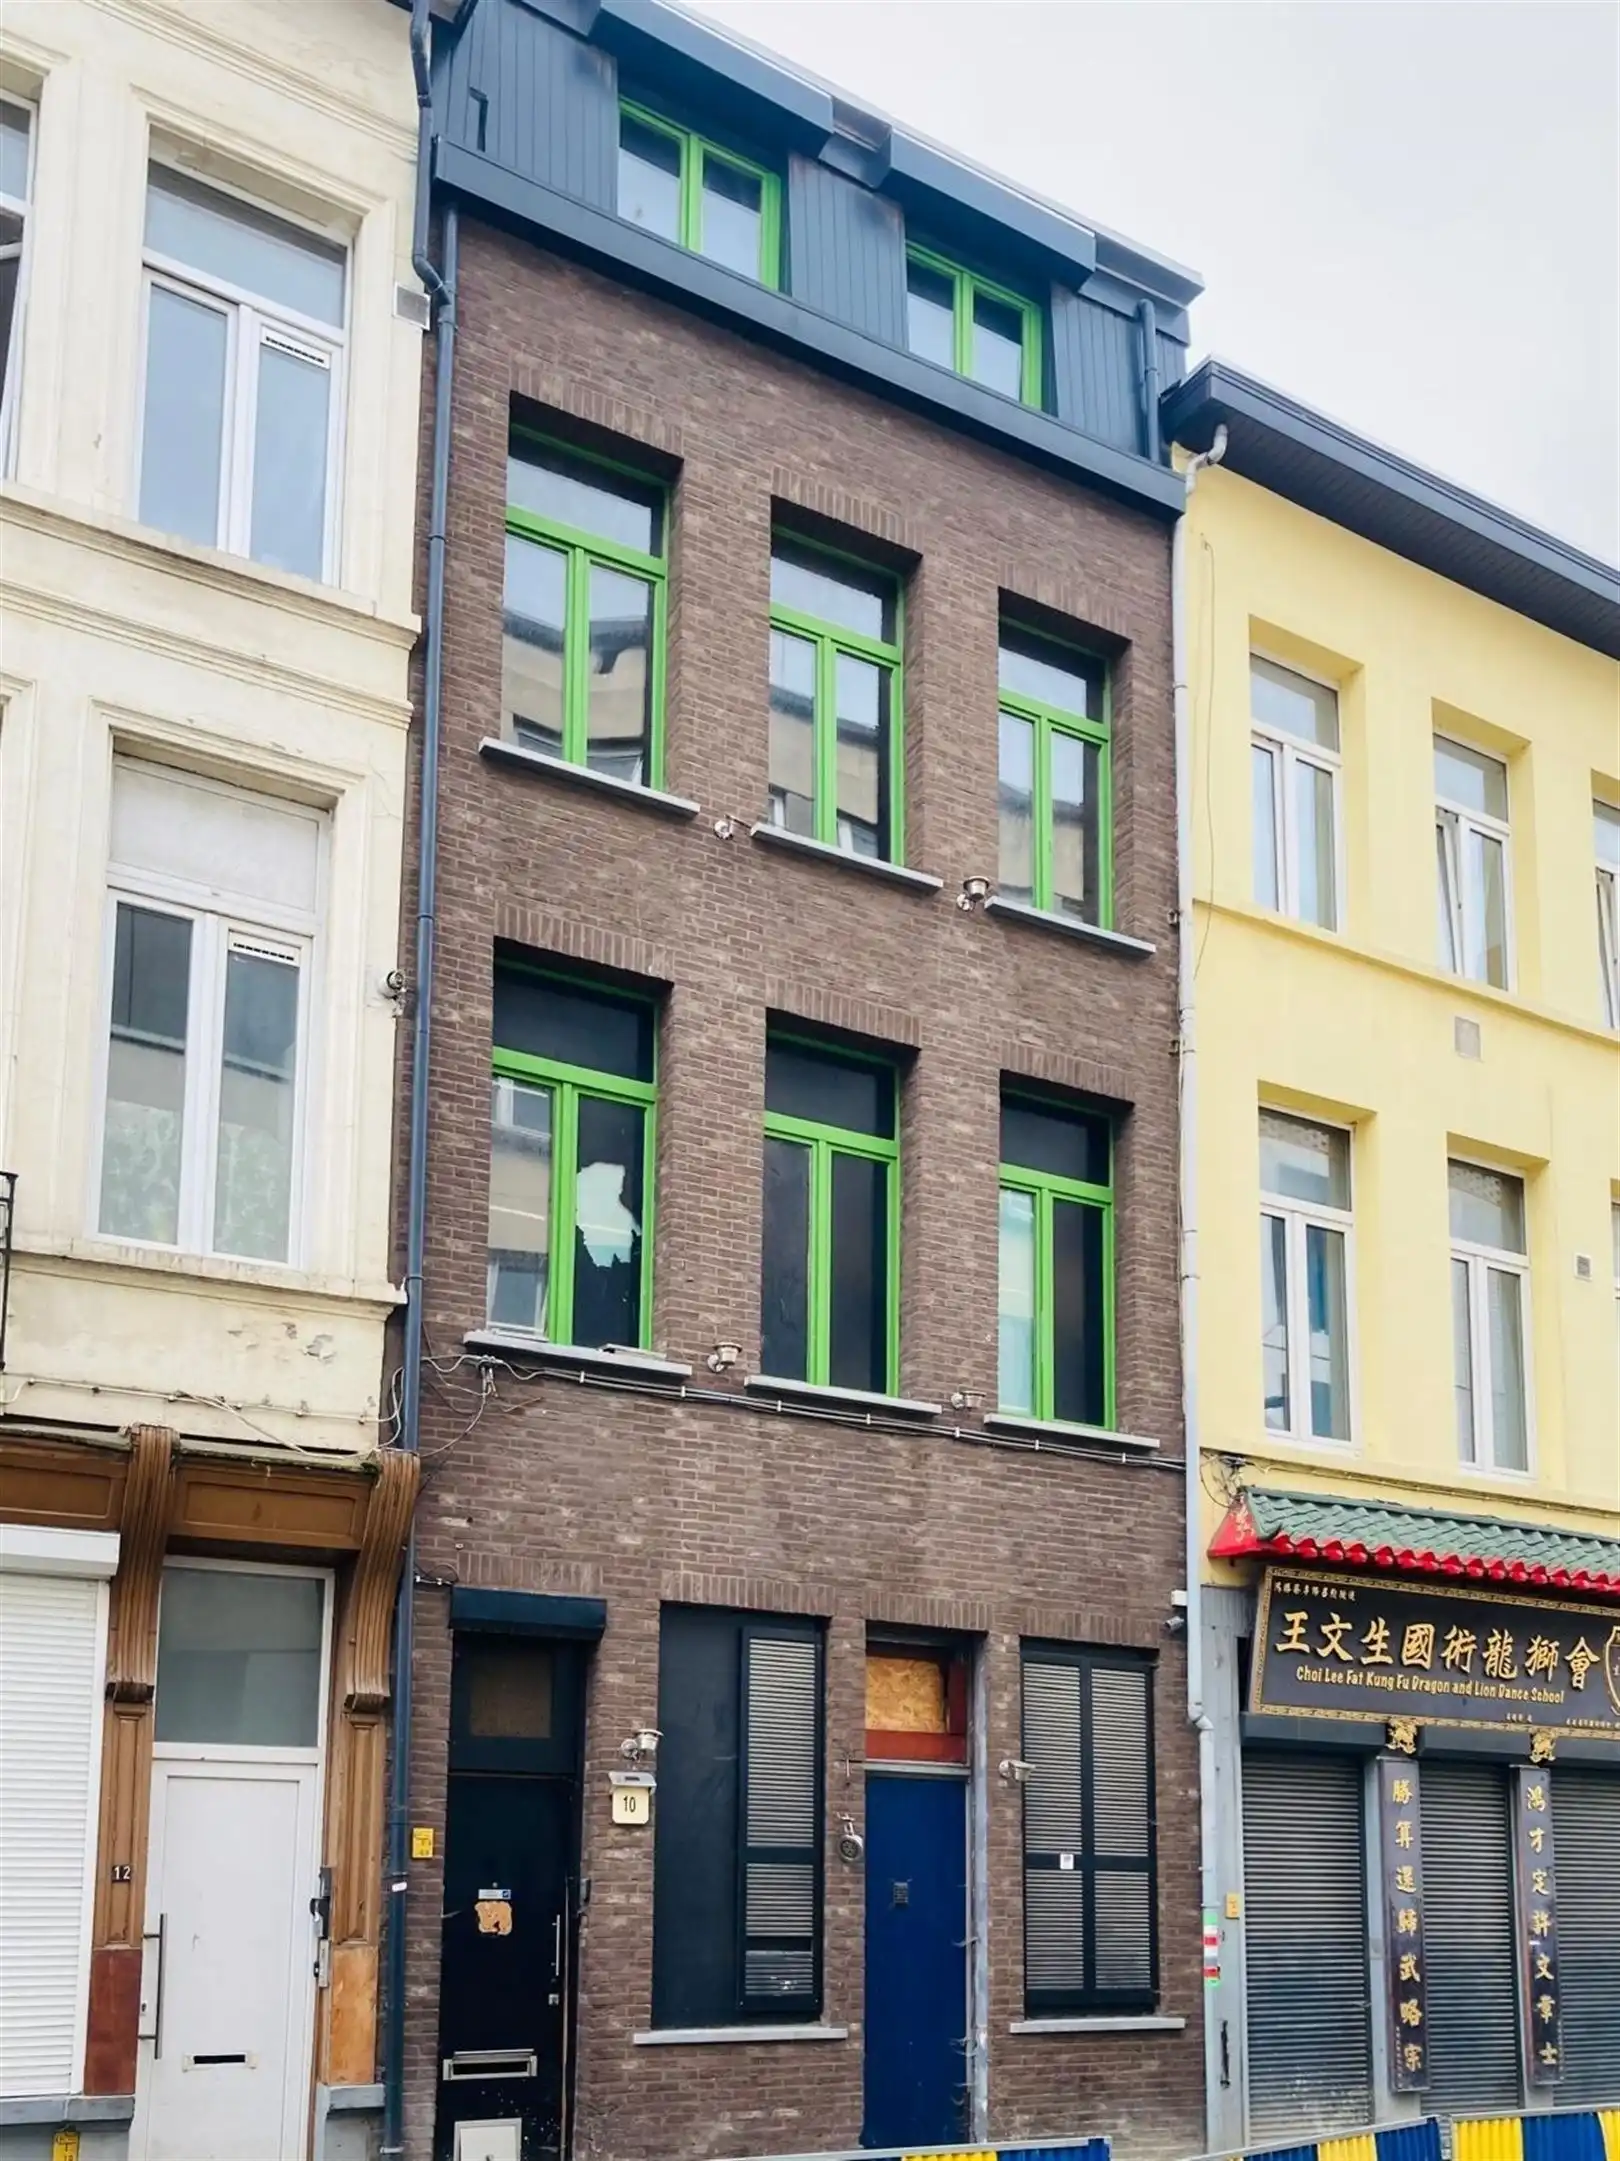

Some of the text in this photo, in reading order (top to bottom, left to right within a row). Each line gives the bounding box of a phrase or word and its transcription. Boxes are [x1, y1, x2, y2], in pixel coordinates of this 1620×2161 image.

[1275, 1611, 1600, 1690] 王文生國術龍獅會
[1296, 1665, 1322, 1682] Choi
[1325, 1667, 1344, 1683] Lee
[1366, 1671, 1394, 1691] Kung
[1396, 1673, 1409, 1689] Fu
[1411, 1675, 1450, 1694] Dragon
[1452, 1680, 1473, 1695] and
[1475, 1681, 1497, 1697] Lion
[1498, 1684, 1529, 1700] Dance
[1531, 1687, 1565, 1704] School
[623, 1795, 636, 1813] 10
[114, 1865, 131, 1880] 12
